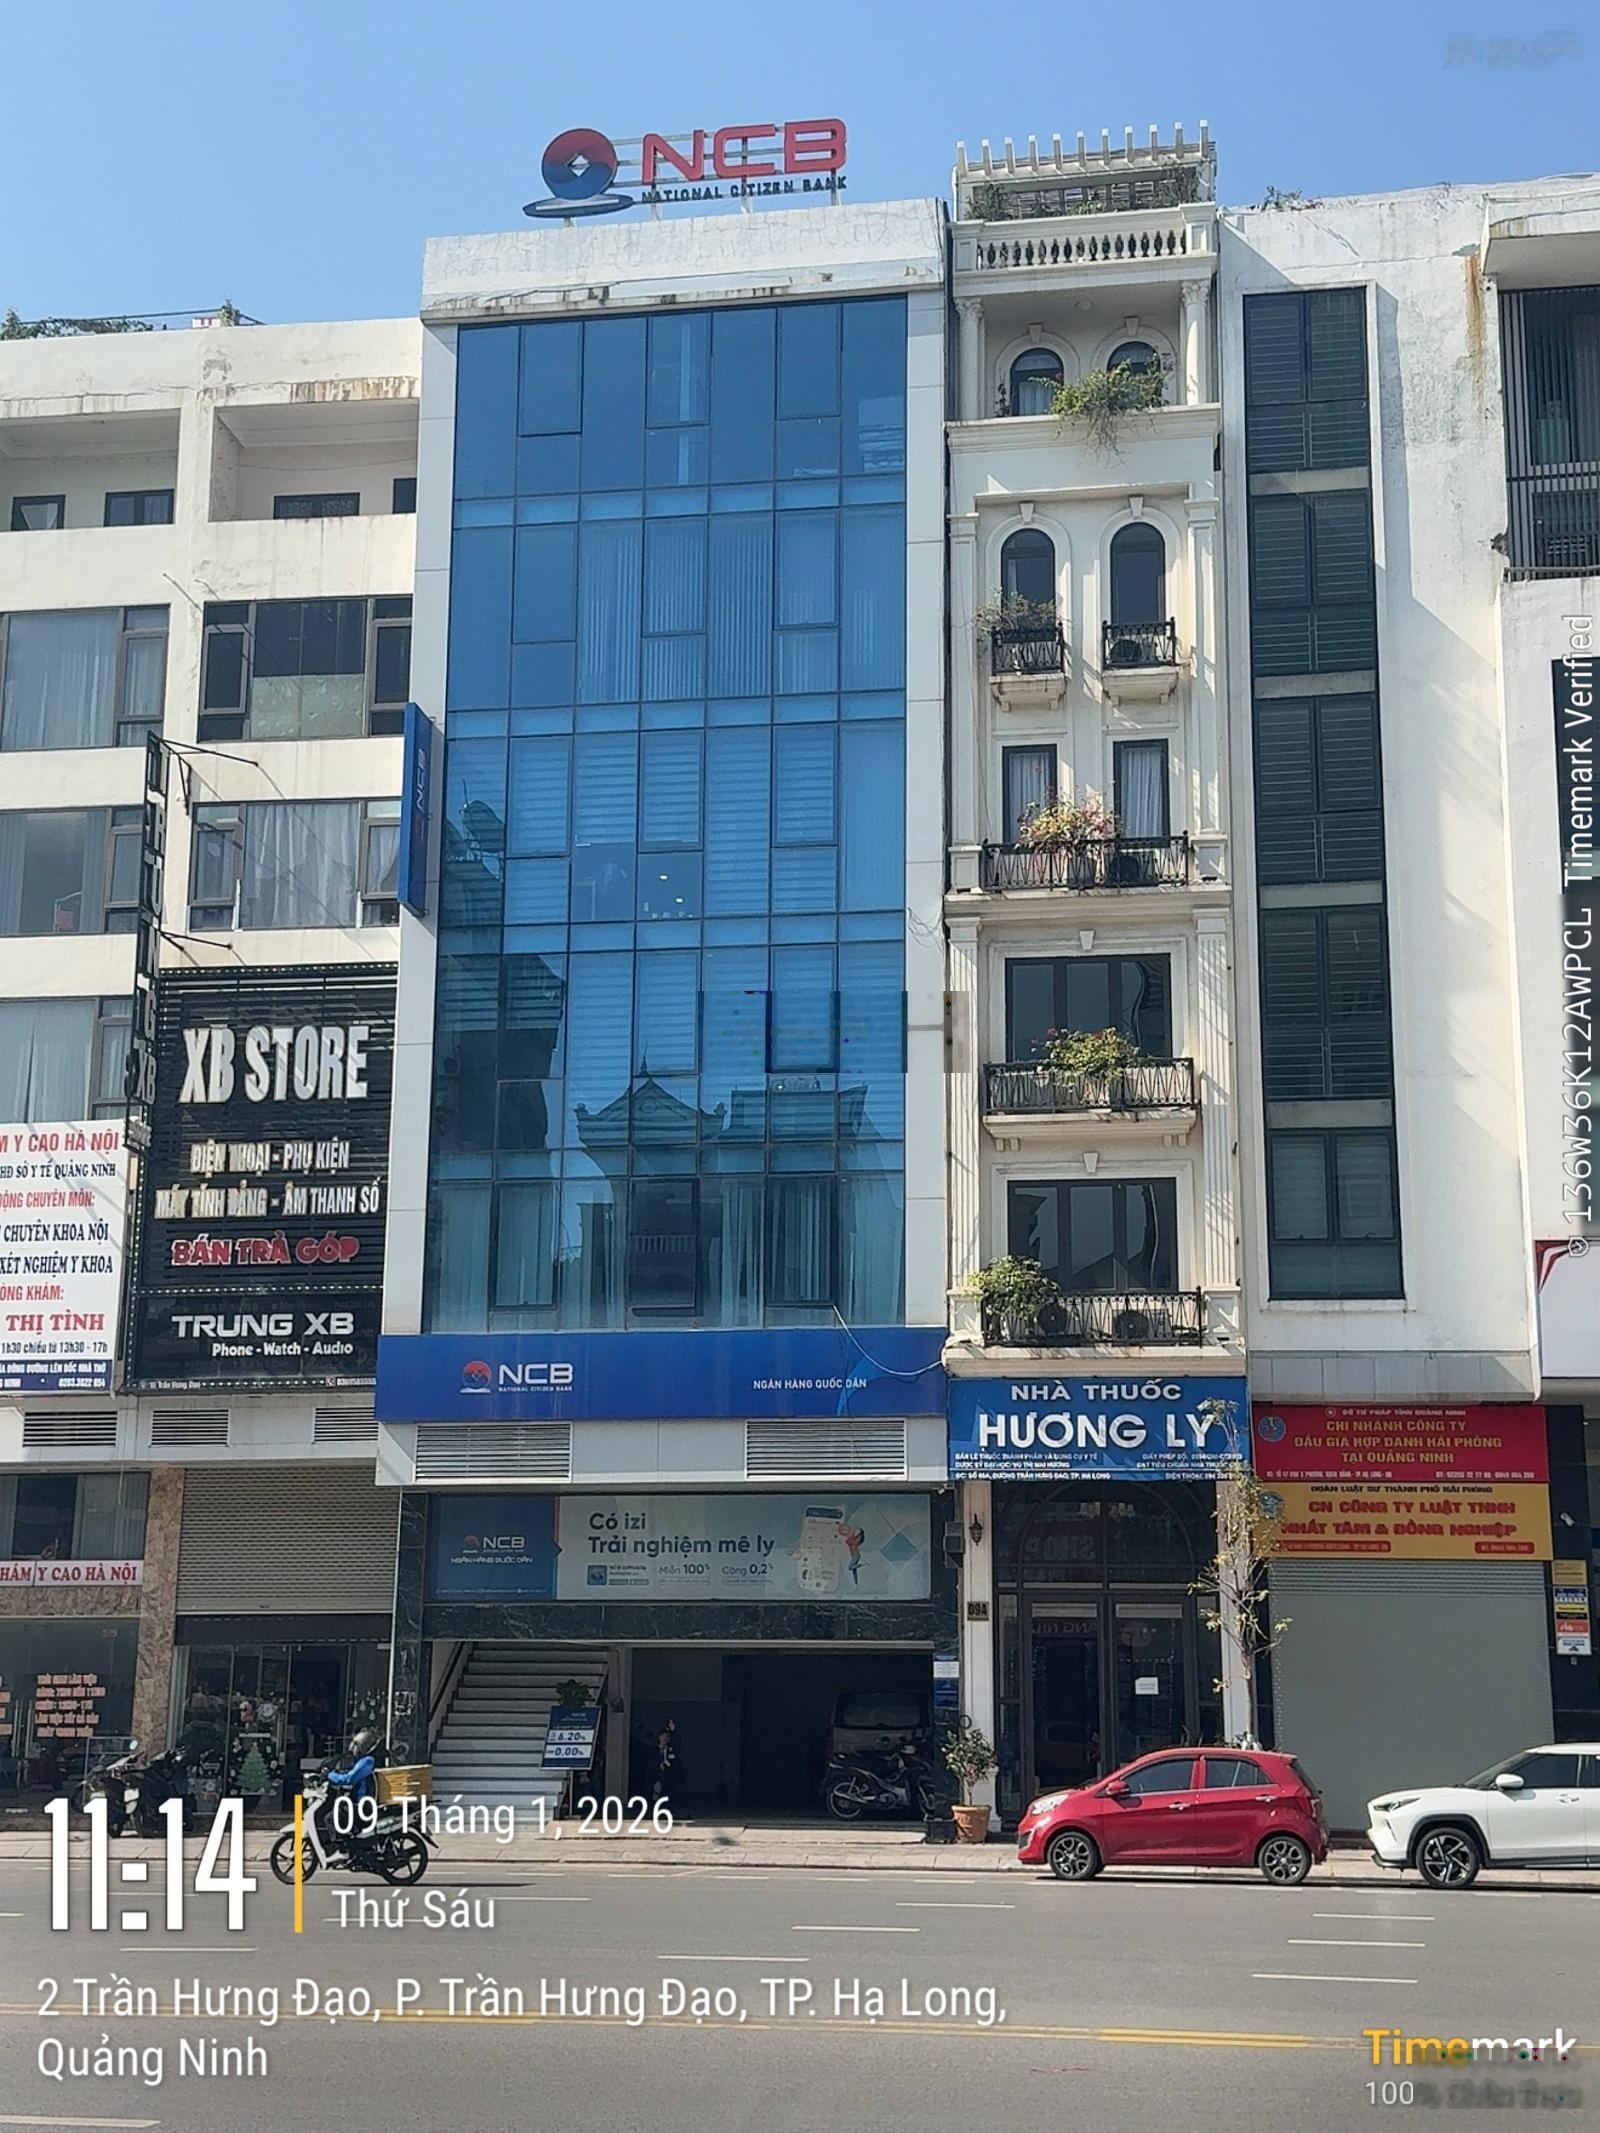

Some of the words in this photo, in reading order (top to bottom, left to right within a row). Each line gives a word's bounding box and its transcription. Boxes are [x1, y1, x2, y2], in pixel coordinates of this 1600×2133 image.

[641, 118, 846, 185] NCB
[641, 186, 723, 203] NATIONAL
[730, 180, 794, 197] CITIZEN
[803, 176, 847, 192] BANK
[179, 1027, 235, 1103] XB
[245, 1025, 369, 1102] STORE
[14, 1134, 23, 1152] Y
[28, 1133, 60, 1152] CAO
[64, 1129, 86, 1151] HÀ
[91, 1128, 119, 1155] NỘI
[31, 1165, 37, 1178] Y
[40, 1158, 54, 1178] TẾ
[54, 1158, 89, 1179] QUẢNG
[91, 1163, 116, 1177] NINH
[190, 1138, 227, 1178] ĐIỆN
[229, 1143, 270, 1177] THOẠI
[283, 1142, 314, 1175] PHỤ
[314, 1136, 349, 1174] KIỆN
[26, 1188, 66, 1208] CHUYÊN
[68, 1187, 95, 1207] MÔN:
[154, 1183, 189, 1219] MÁY
[282, 1181, 309, 1216] ÂM
[309, 1187, 356, 1215] THANH
[360, 1176, 381, 1214] SỐ
[4, 1218, 50, 1242] CHUYÊN
[53, 1223, 85, 1241] KHOA
[88, 1218, 109, 1246] NỘI
[171, 1233, 231, 1266] BÁN
[236, 1229, 291, 1264] TRẢ
[295, 1231, 360, 1264] GÓP
[23, 1250, 68, 1278] NGHIỆM
[71, 1256, 79, 1274] Y
[80, 1256, 113, 1274] KHOA
[26, 1282, 64, 1301] KHÁM:
[6, 1314, 44, 1335] THỊ
[50, 1308, 104, 1331] TÌNH
[172, 1313, 293, 1338] TRUNG
[303, 1313, 355, 1337] XB
[60, 1341, 84, 1353] 13h30
[211, 1344, 253, 1358] Phone
[263, 1342, 301, 1357] Watch
[312, 1340, 353, 1356] Audio
[498, 1362, 574, 1385] NCB
[753, 1377, 782, 1390] NGÂN
[784, 1376, 813, 1389] HÀNG
[815, 1375, 843, 1389] QUỐC
[845, 1377, 867, 1388] DÂN
[1011, 1379, 1071, 1401] NHÀ
[1083, 1378, 1181, 1400] THUỐC
[979, 1411, 1146, 1448] HƯƠNG
[1326, 1421, 1349, 1431] CHI
[1353, 1419, 1402, 1431] NHÁNH
[1406, 1419, 1445, 1431] CÔNG
[1449, 1421, 1466, 1431] TY
[1353, 1435, 1381, 1449] HỢP
[1427, 1434, 1451, 1447] HẢI
[1454, 1435, 1502, 1448] PHÒNG
[1342, 1451, 1363, 1465] TẠI
[1366, 1450, 1415, 1463] QUẢNG
[1419, 1452, 1454, 1463] NINH
[1308, 1501, 1333, 1513] CN
[1339, 1499, 1388, 1513] CÔNG
[1393, 1501, 1414, 1513] TY
[1419, 1499, 1462, 1516] LUẬT
[1467, 1502, 1516, 1514] TNHH
[589, 1512, 618, 1531] Có
[624, 1512, 647, 1531] izi
[1332, 1520, 1371, 1535] TÂM
[1375, 1522, 1389, 1535] &
[1449, 1522, 1517, 1538] NGHIỆP
[482, 1535, 525, 1549] NCB
[588, 1535, 627, 1554] Trải
[633, 1535, 713, 1559] nghiệm
[718, 1535, 750, 1554] mê
[754, 1535, 774, 1559] ly
[37, 1566, 48, 1581] Y
[51, 1566, 81, 1581] CAO
[85, 1562, 106, 1581] HÀ
[110, 1562, 137, 1585] NỘI
[968, 1603, 988, 1616] 09A
